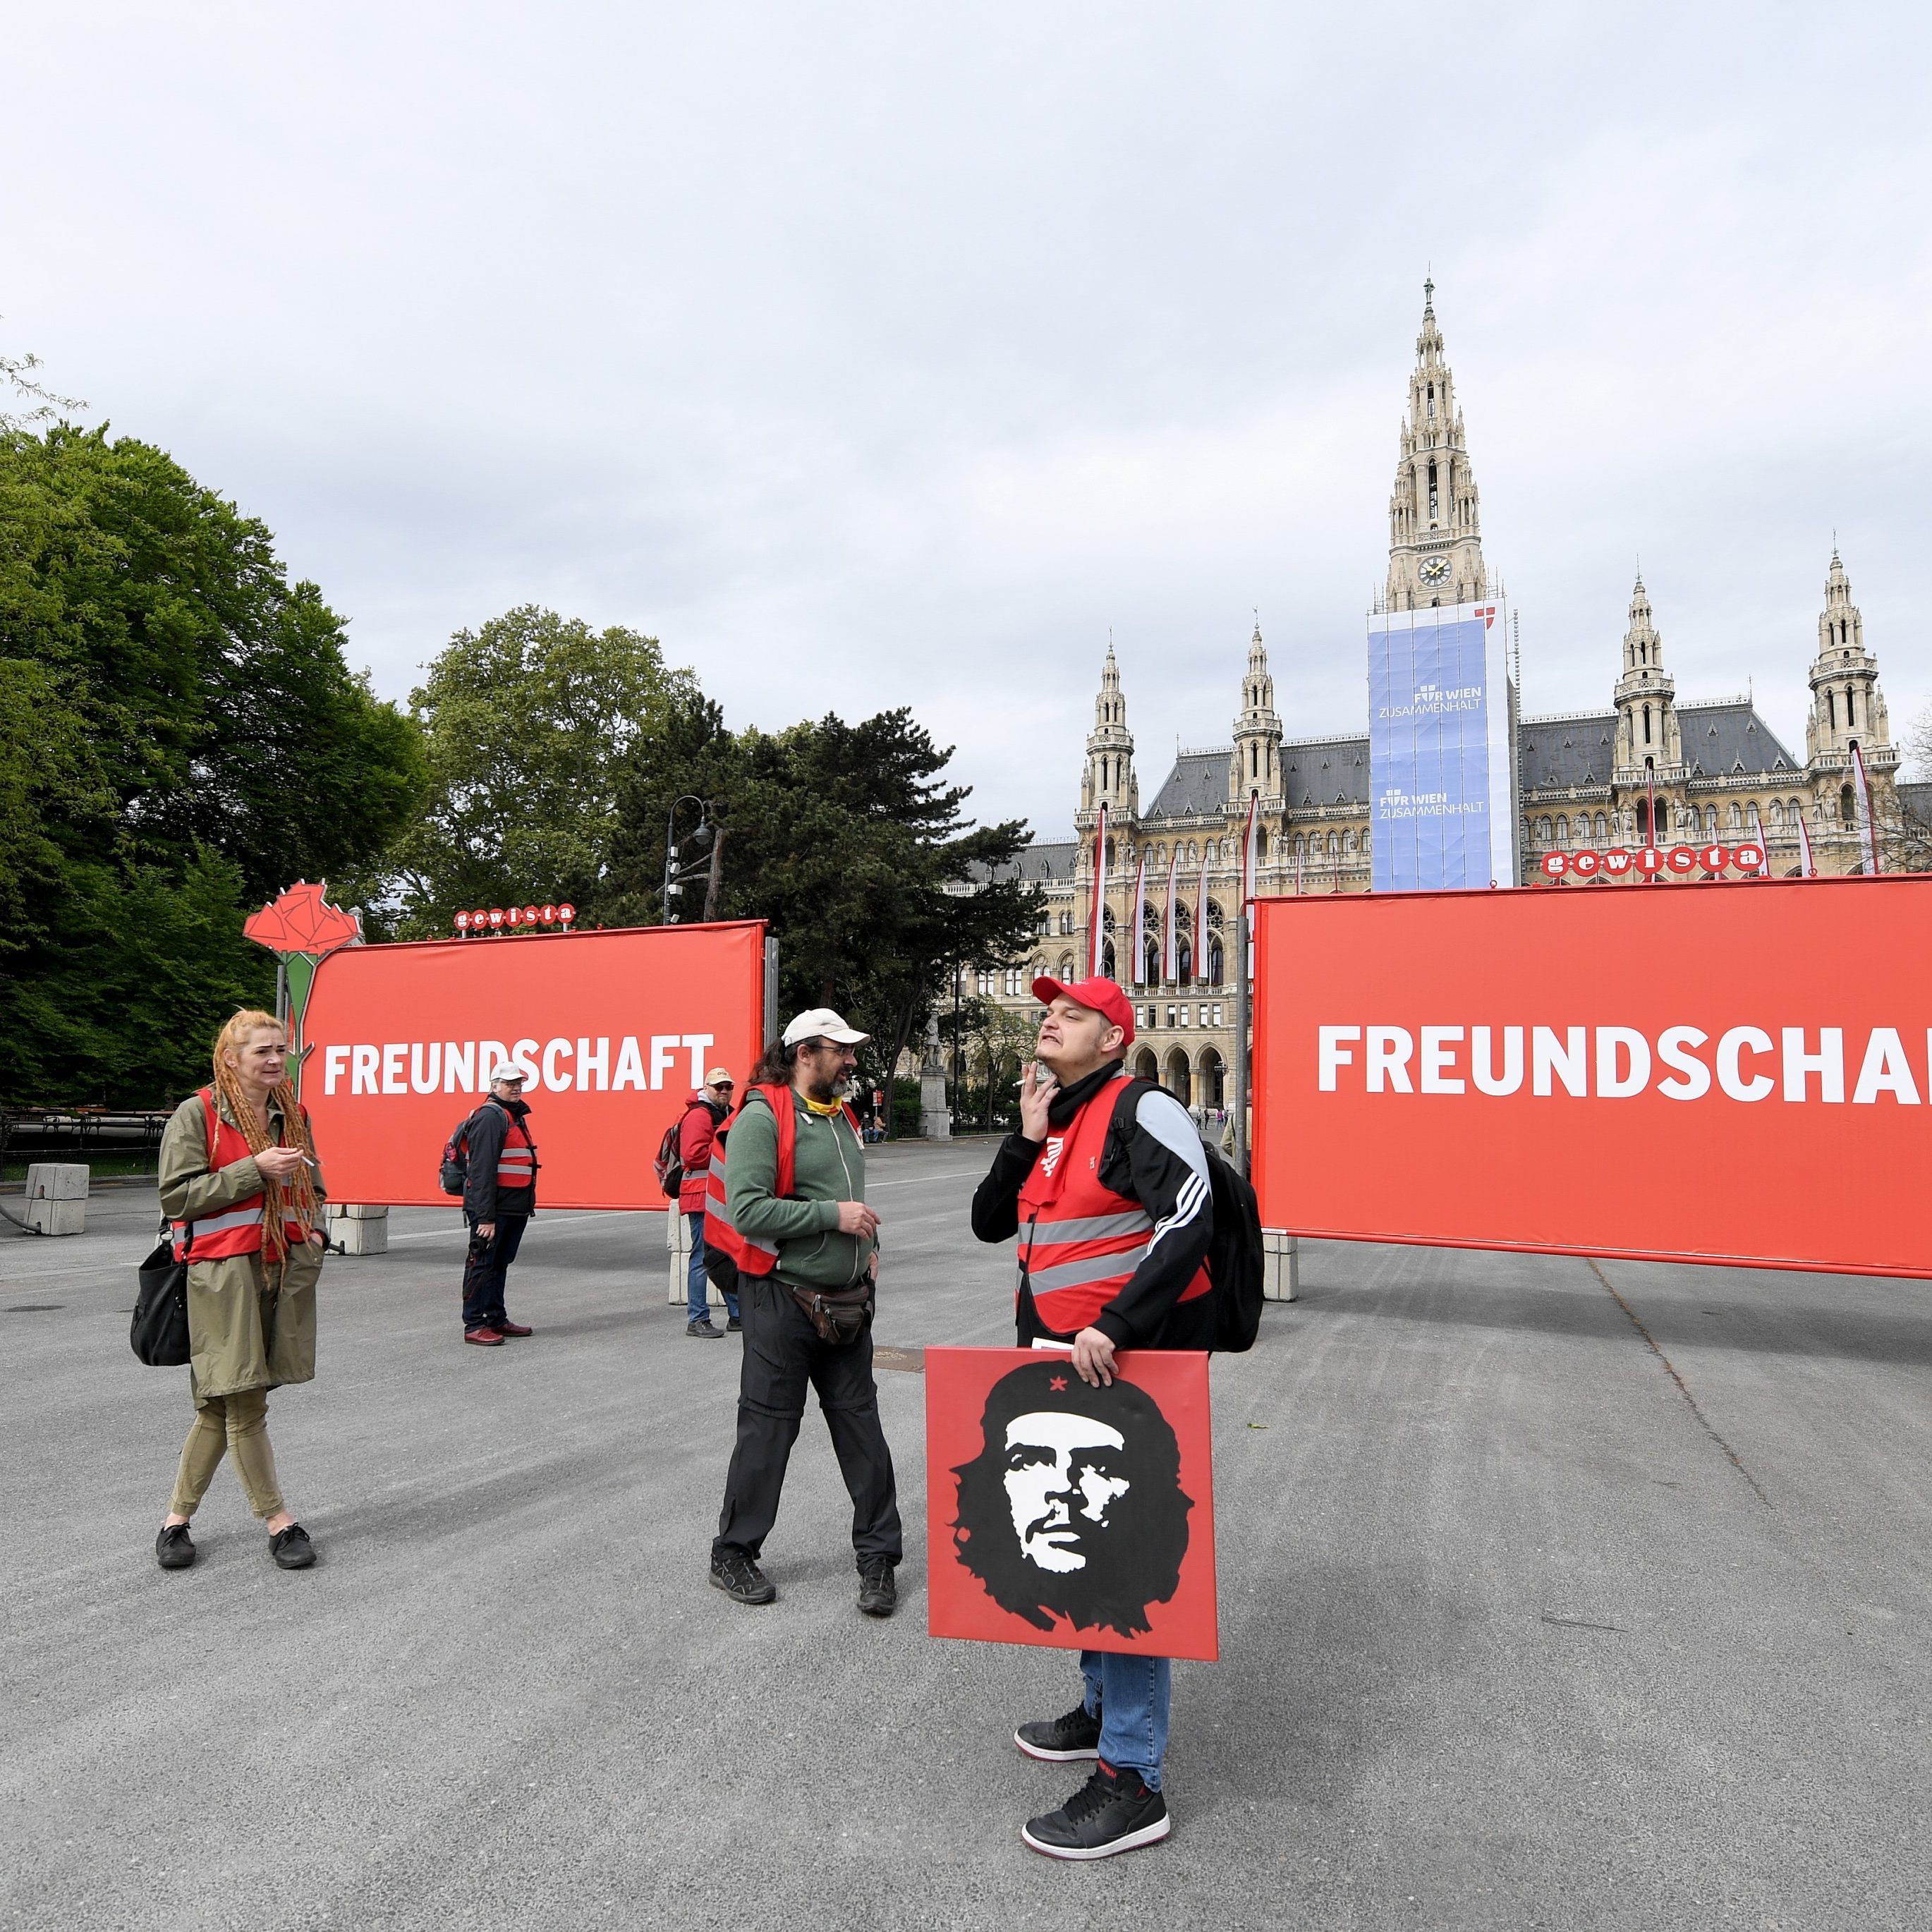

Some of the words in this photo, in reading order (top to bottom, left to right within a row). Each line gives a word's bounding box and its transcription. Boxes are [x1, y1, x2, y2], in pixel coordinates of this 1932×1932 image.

[1446, 687, 1481, 700] WIEN
[1379, 698, 1481, 718] ZUSAMMENHALT
[1411, 793, 1447, 805] WIEN
[1380, 801, 1484, 819] ZUSAMMENHALT
[1548, 846, 1760, 873] gewista
[457, 906, 572, 928] gewista
[324, 1033, 715, 1095] FREUNDSCHAFT
[1318, 1026, 1932, 1105] FREUNDSCHA
